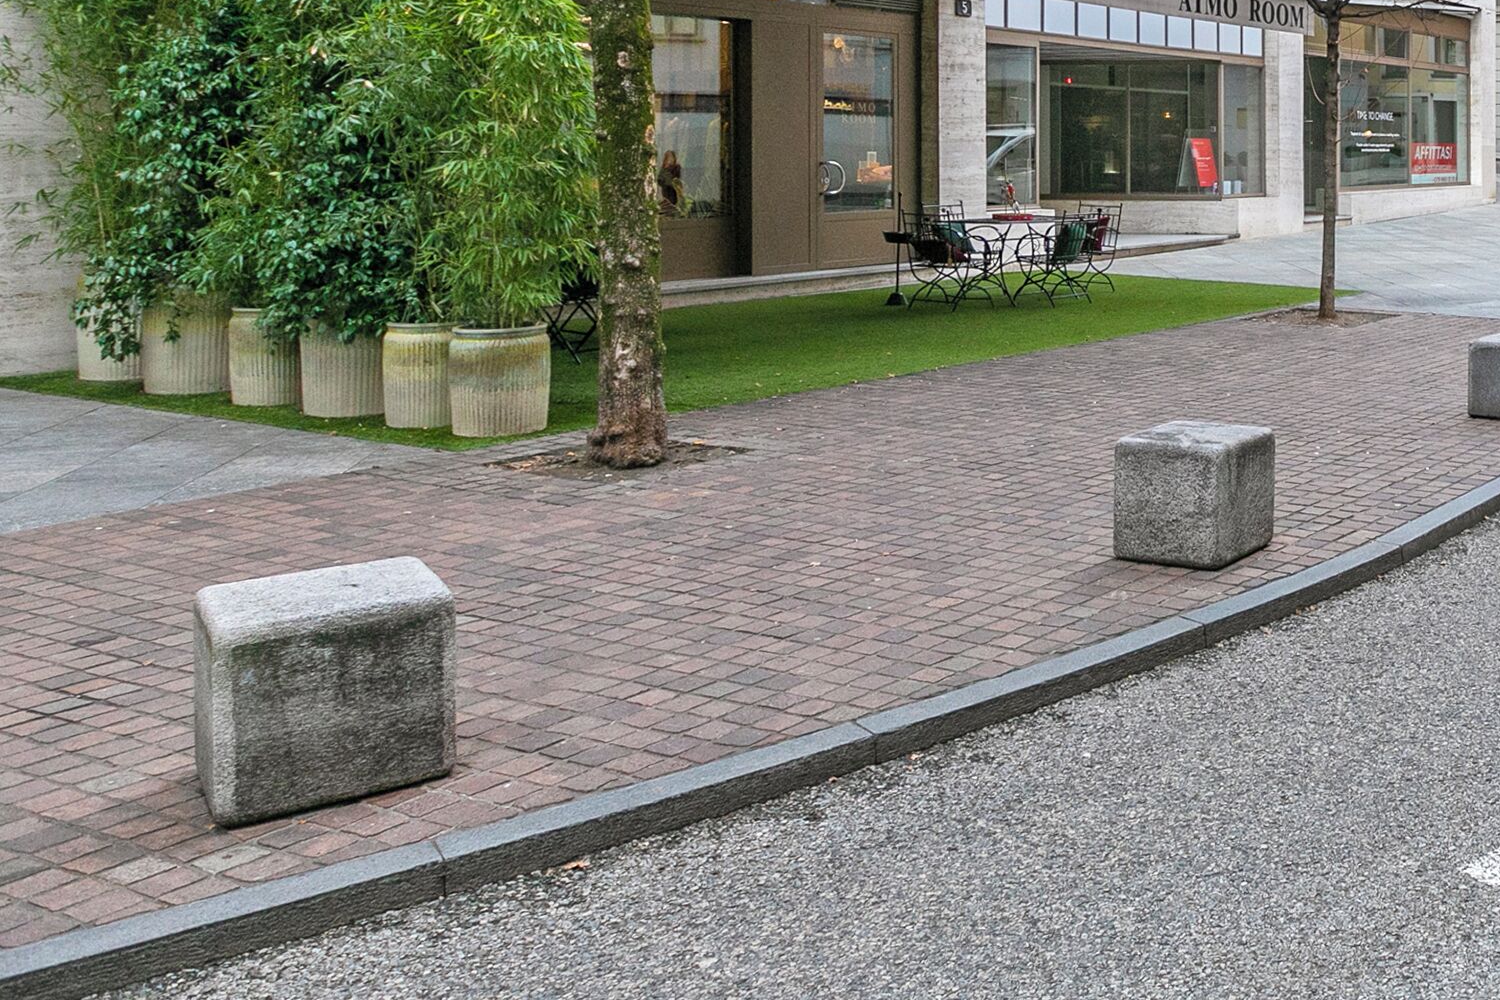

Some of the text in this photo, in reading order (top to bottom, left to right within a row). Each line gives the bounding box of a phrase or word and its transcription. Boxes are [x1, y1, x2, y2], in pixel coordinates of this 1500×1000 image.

[961, 1, 969, 14] 5
[841, 113, 876, 124] ROOM
[1414, 145, 1453, 160] AFFITTASI
